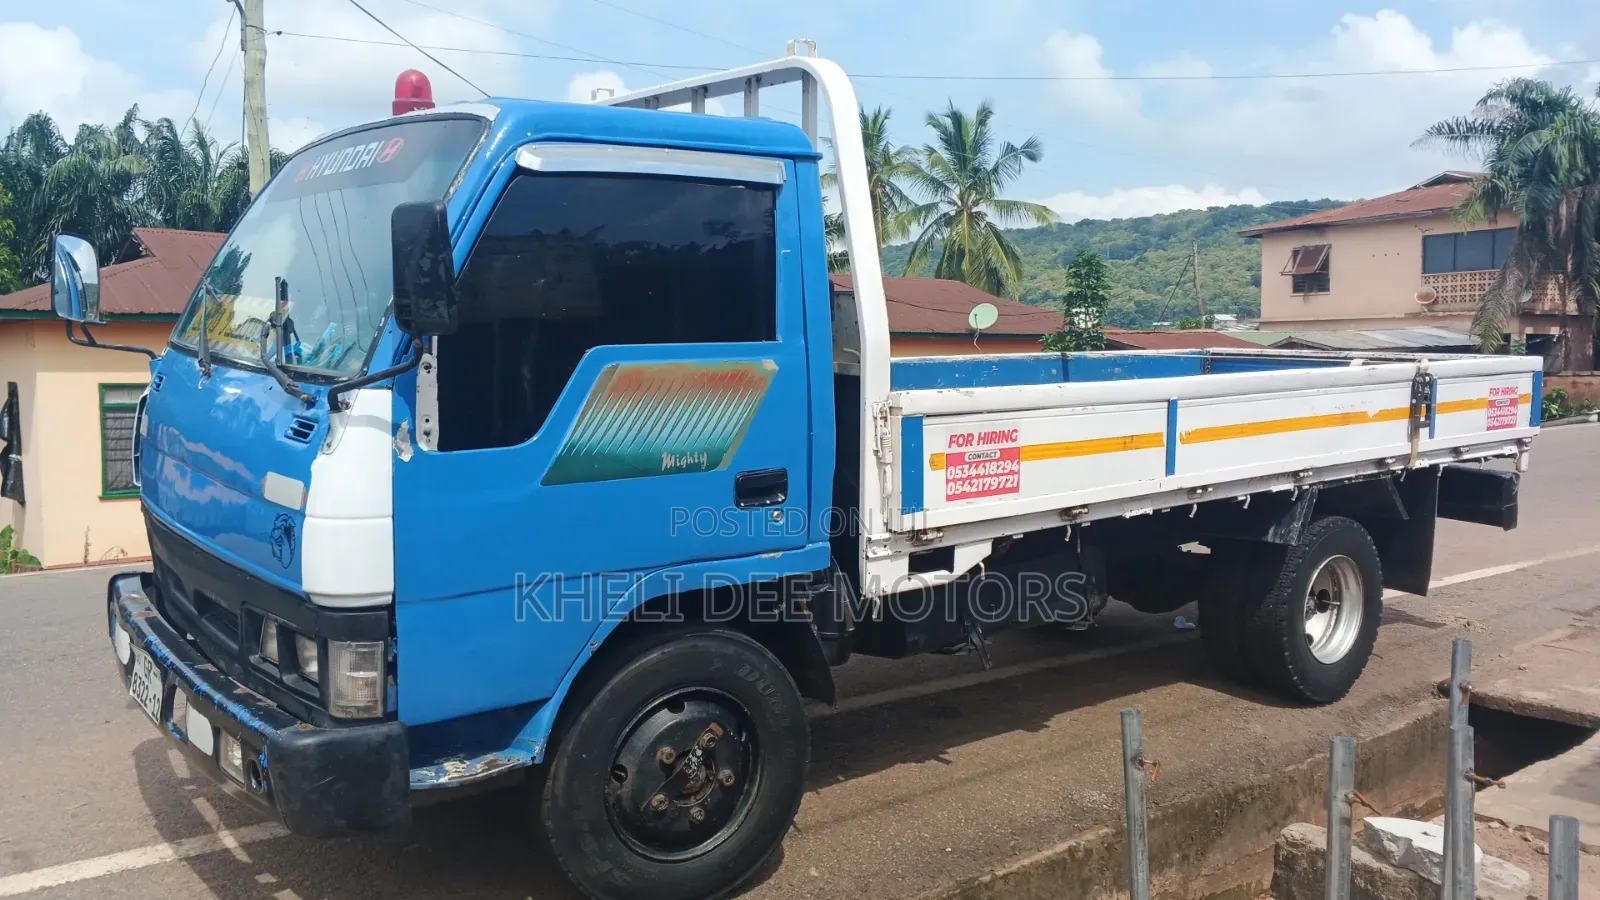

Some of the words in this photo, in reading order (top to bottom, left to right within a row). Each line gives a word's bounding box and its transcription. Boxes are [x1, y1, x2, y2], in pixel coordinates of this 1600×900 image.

[305, 140, 385, 181] HYUNDAI
[1489, 388, 1500, 397] FOR
[948, 432, 974, 449] FOR
[977, 428, 1019, 446] HIRING
[661, 451, 708, 472] Mighty
[967, 450, 998, 461] CONTACT
[946, 458, 1019, 480] 0534418294
[946, 474, 1019, 496] 0542179721
